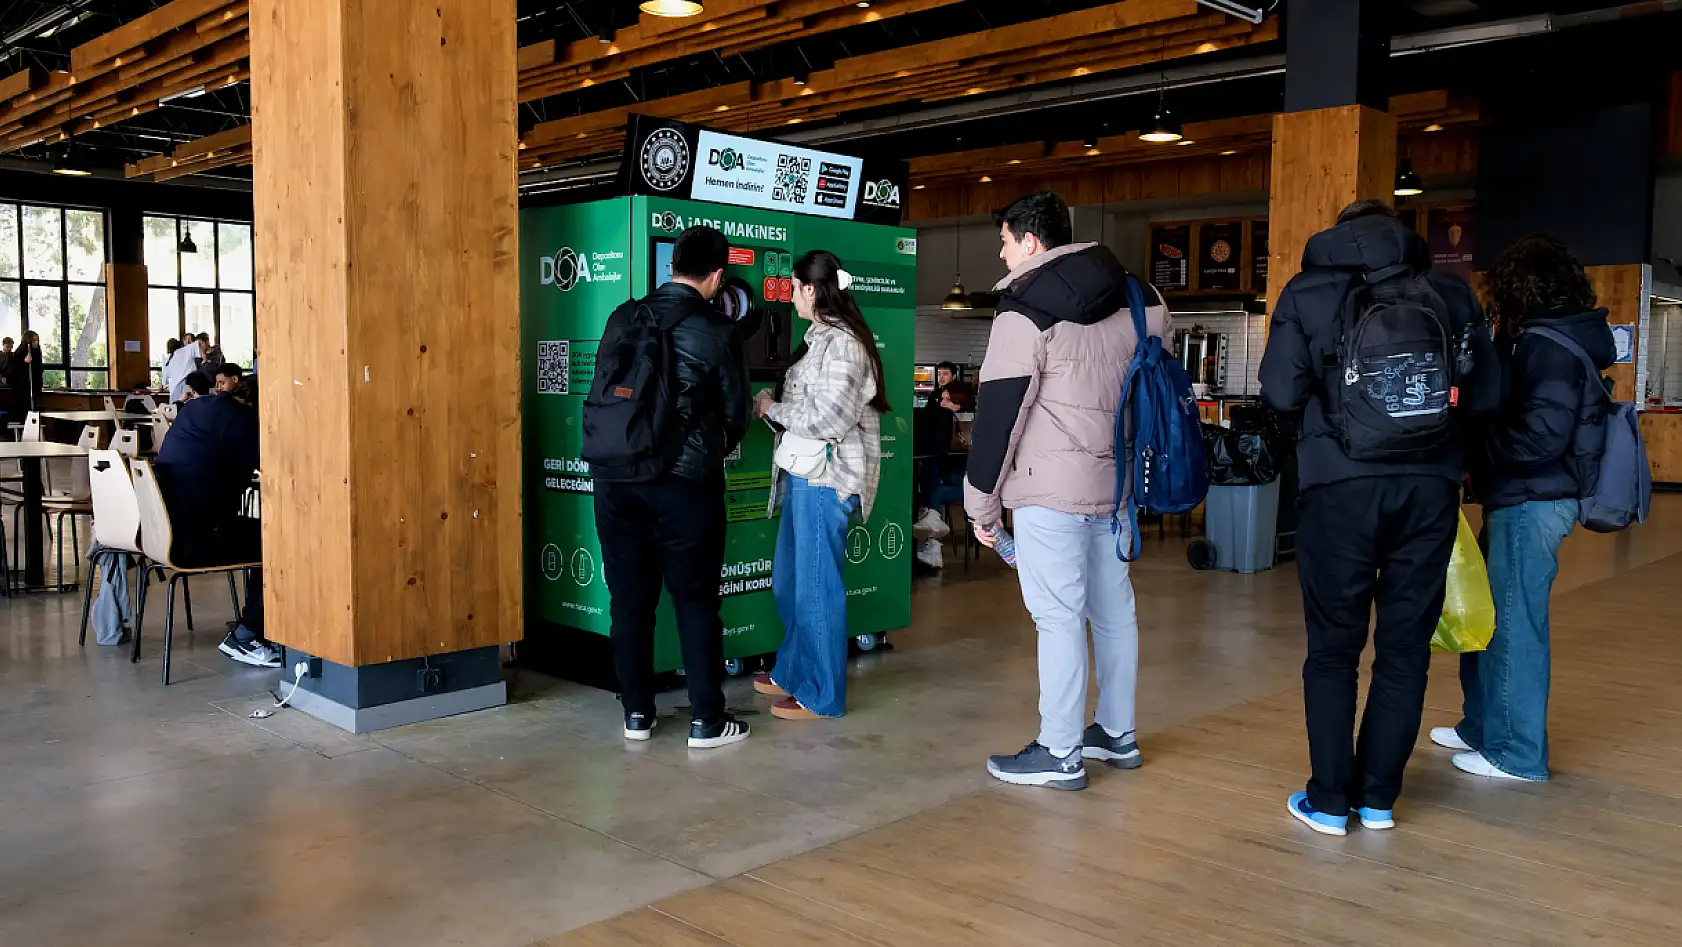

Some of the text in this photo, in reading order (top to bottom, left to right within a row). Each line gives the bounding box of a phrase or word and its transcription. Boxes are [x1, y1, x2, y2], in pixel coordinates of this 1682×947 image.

[708, 147, 745, 171] DOA
[705, 176, 734, 189] Hemen
[864, 179, 900, 204] DOA
[651, 210, 685, 233] DOA
[540, 246, 592, 292] DOA
[1405, 373, 1427, 385] LIFE
[544, 457, 565, 471] GERİ
[720, 558, 772, 578] ÖNÜŞTÜR
